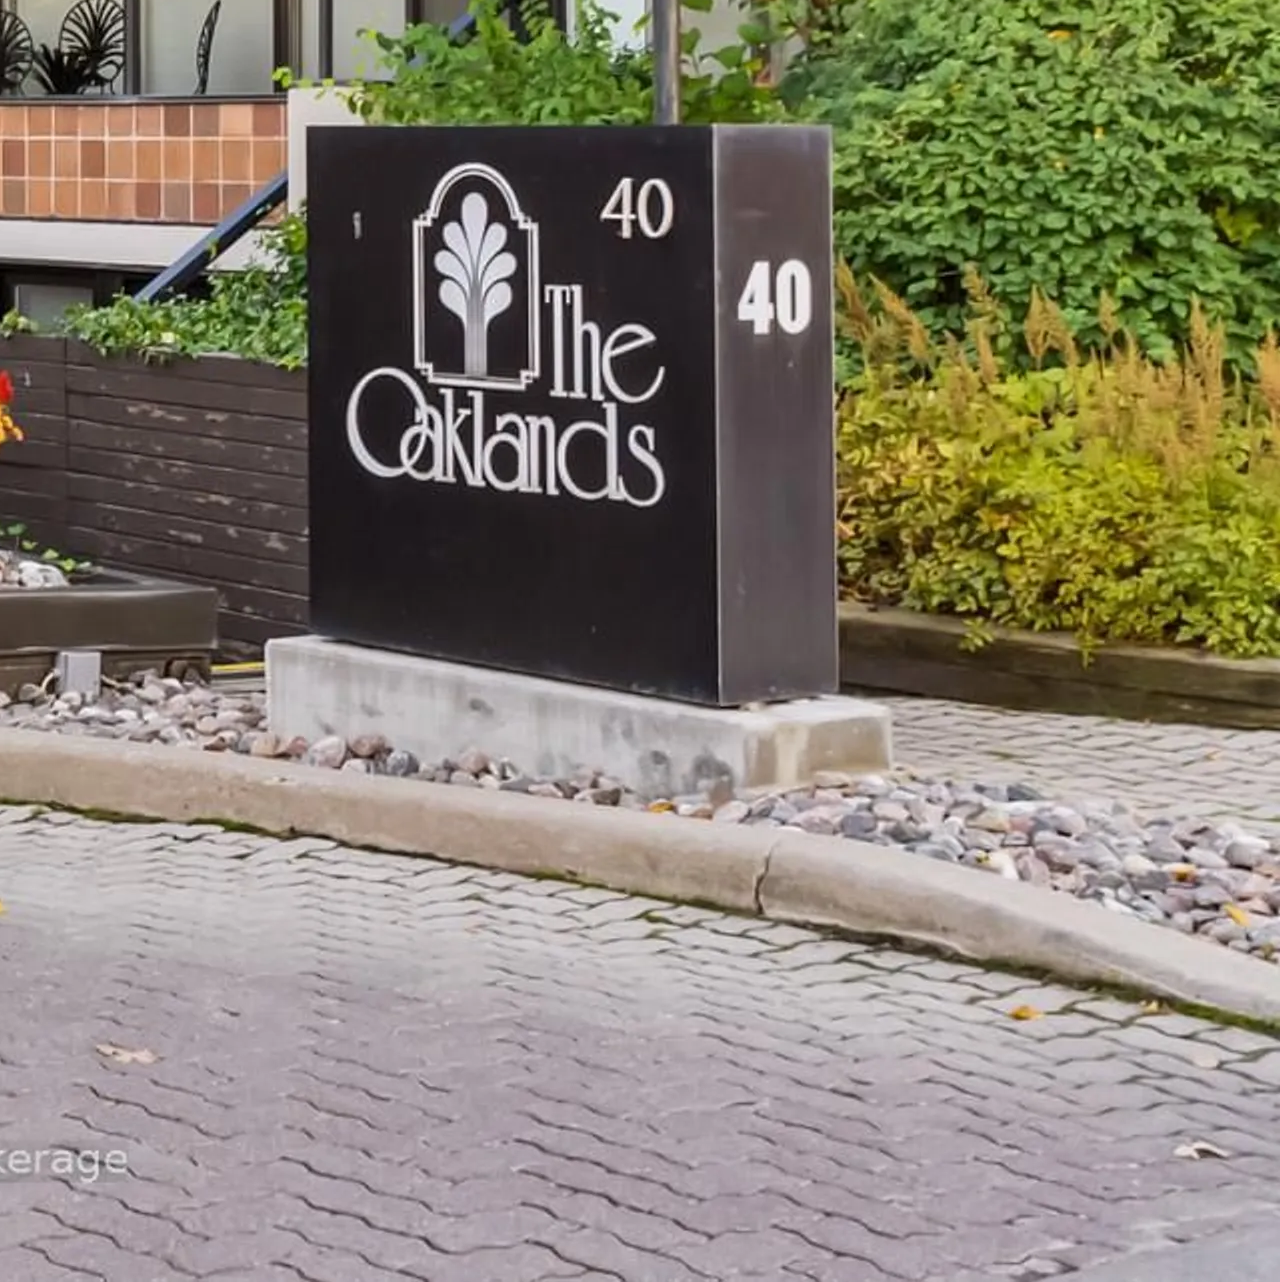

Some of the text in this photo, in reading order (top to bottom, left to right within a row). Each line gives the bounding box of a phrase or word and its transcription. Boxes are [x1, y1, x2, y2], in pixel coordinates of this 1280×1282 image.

[600, 177, 675, 240] 40
[544, 283, 666, 405] The
[738, 259, 813, 336] 40
[346, 366, 667, 508] Oaklands
